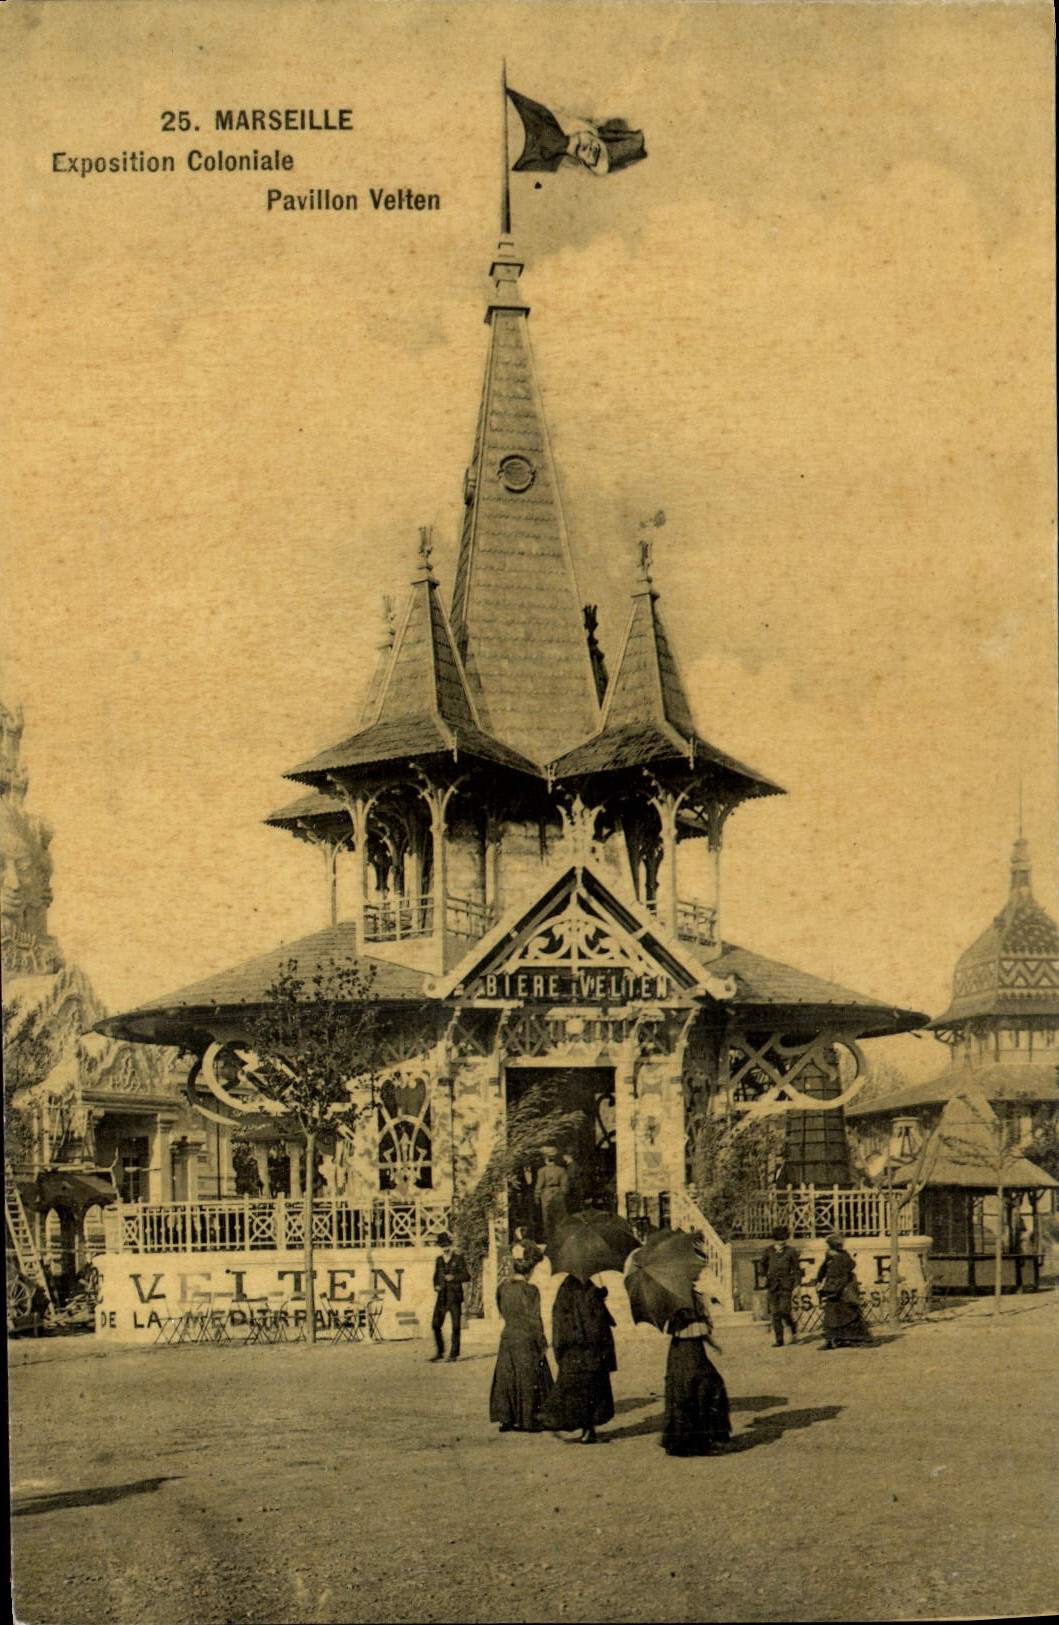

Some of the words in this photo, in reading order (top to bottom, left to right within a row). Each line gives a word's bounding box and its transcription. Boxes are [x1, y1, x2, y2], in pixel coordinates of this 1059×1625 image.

[486, 974, 560, 998] BIERE
[579, 974, 668, 999] VELTEN
[129, 1268, 405, 1304] VELTEN
[133, 1309, 163, 1329] LA
